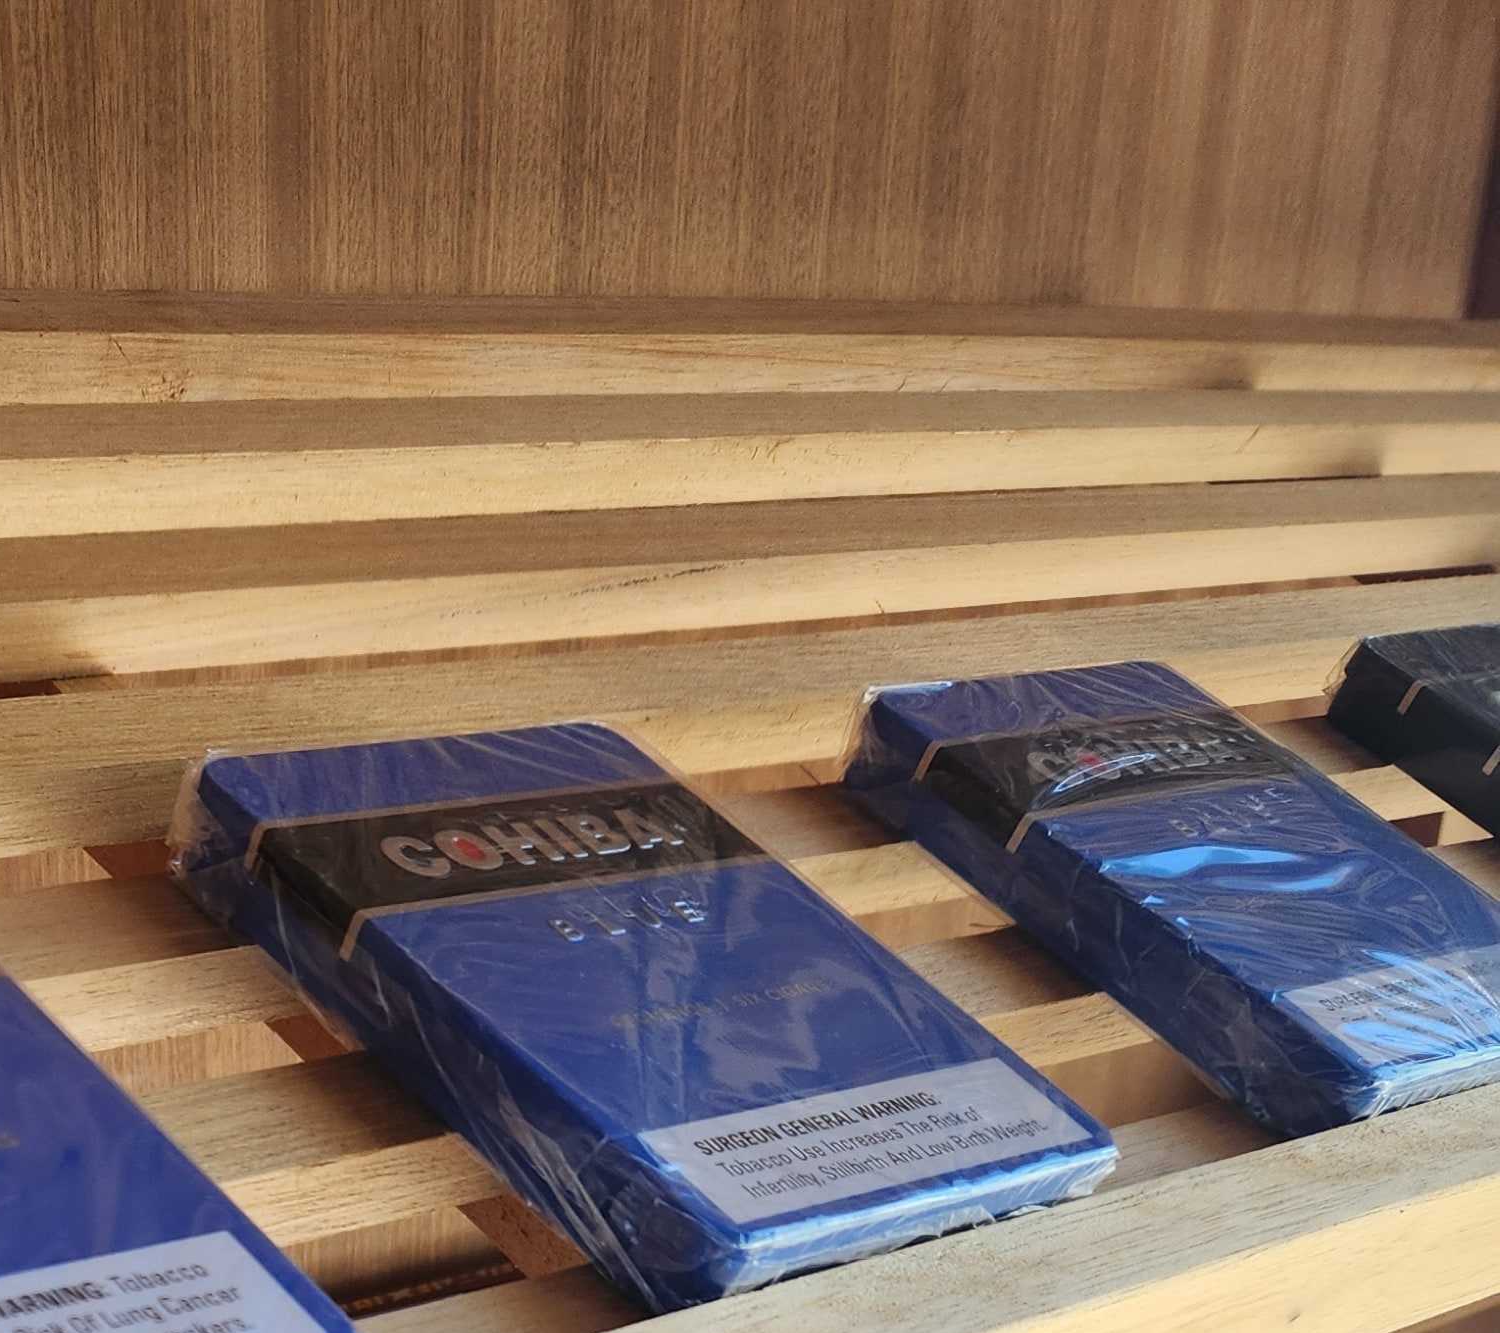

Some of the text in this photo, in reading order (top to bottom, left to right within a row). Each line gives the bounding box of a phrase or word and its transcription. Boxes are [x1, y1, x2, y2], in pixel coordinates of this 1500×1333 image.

[380, 807, 685, 880] COHIBA
[548, 898, 705, 943] BLUE
[693, 1091, 942, 1156] SURGEON GENERAL WARNING:
[715, 1105, 982, 1178] Tobacco Use Increases The Risk of
[741, 1171, 827, 1201] Infertility,
[817, 1154, 887, 1183] Stillbirth
[889, 1147, 920, 1166] And
[921, 1142, 956, 1160] Low
[952, 1130, 993, 1151] Birth
[109, 1260, 209, 1301] Tobacco
[163, 1282, 245, 1321] Cancer
